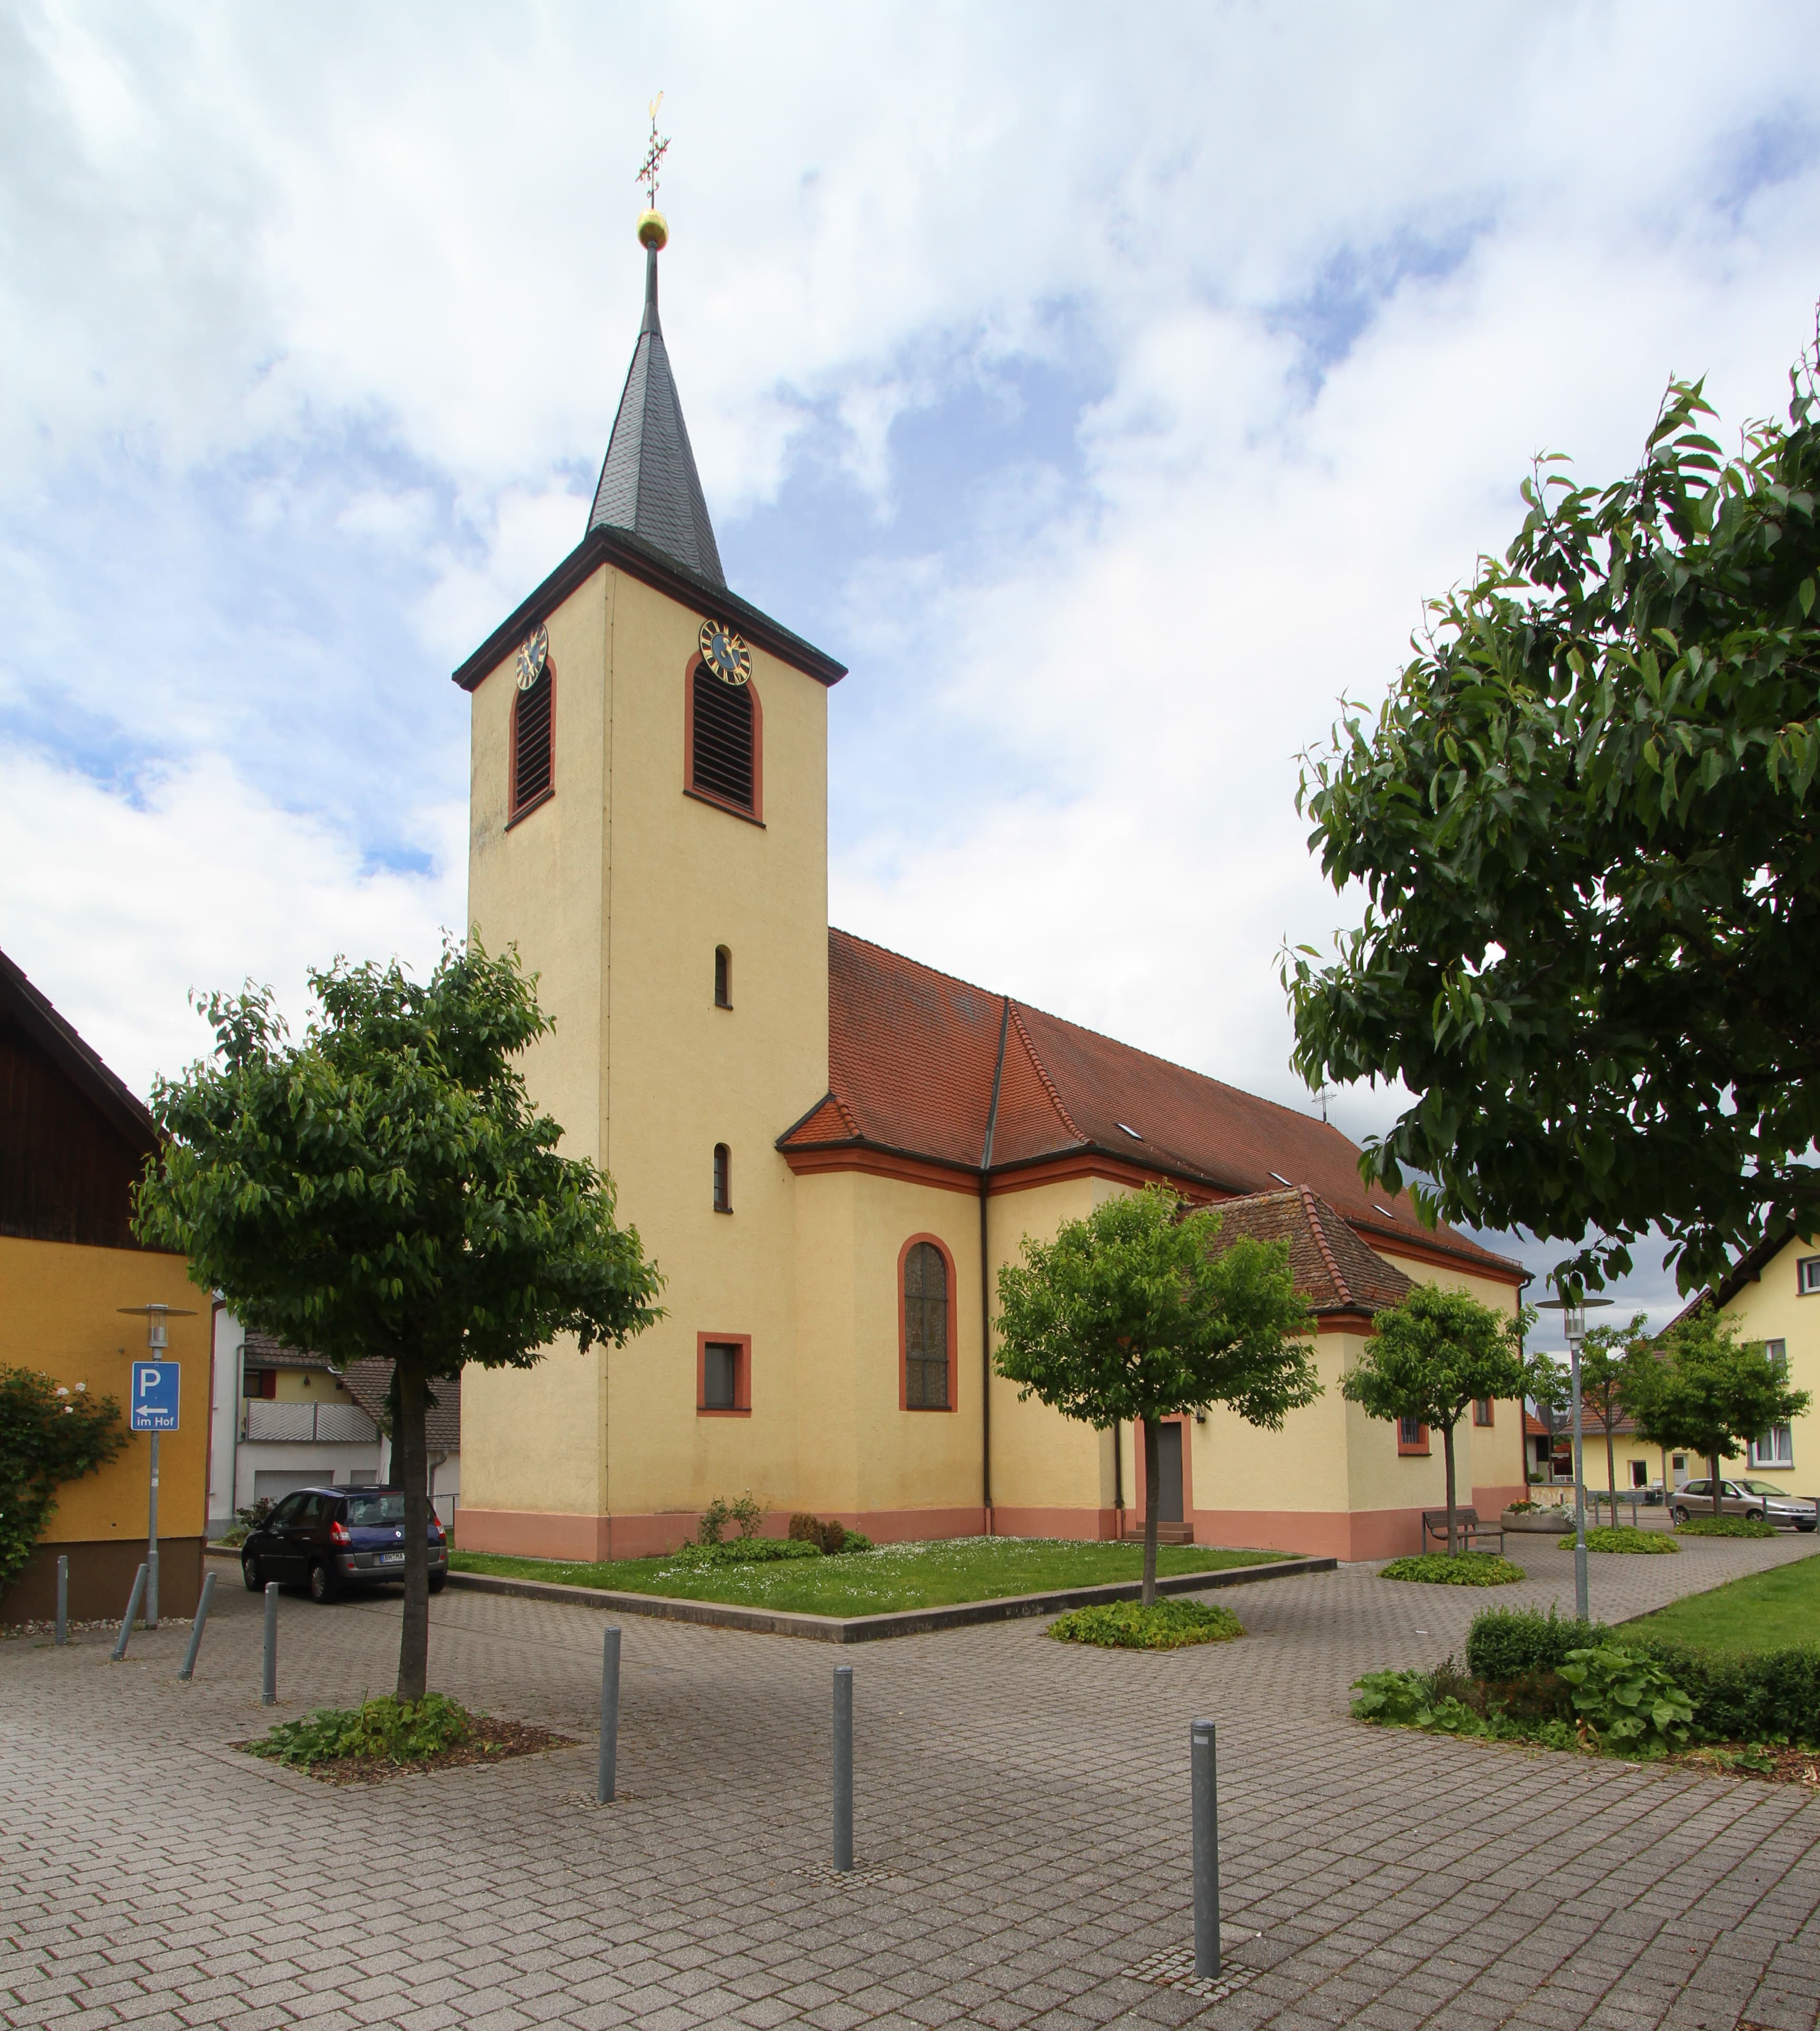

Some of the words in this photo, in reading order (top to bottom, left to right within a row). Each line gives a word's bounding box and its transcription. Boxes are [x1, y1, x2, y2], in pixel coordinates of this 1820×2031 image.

[140, 1369, 161, 1397] P
[137, 1416, 151, 1426] im
[155, 1416, 174, 1426] Hof
